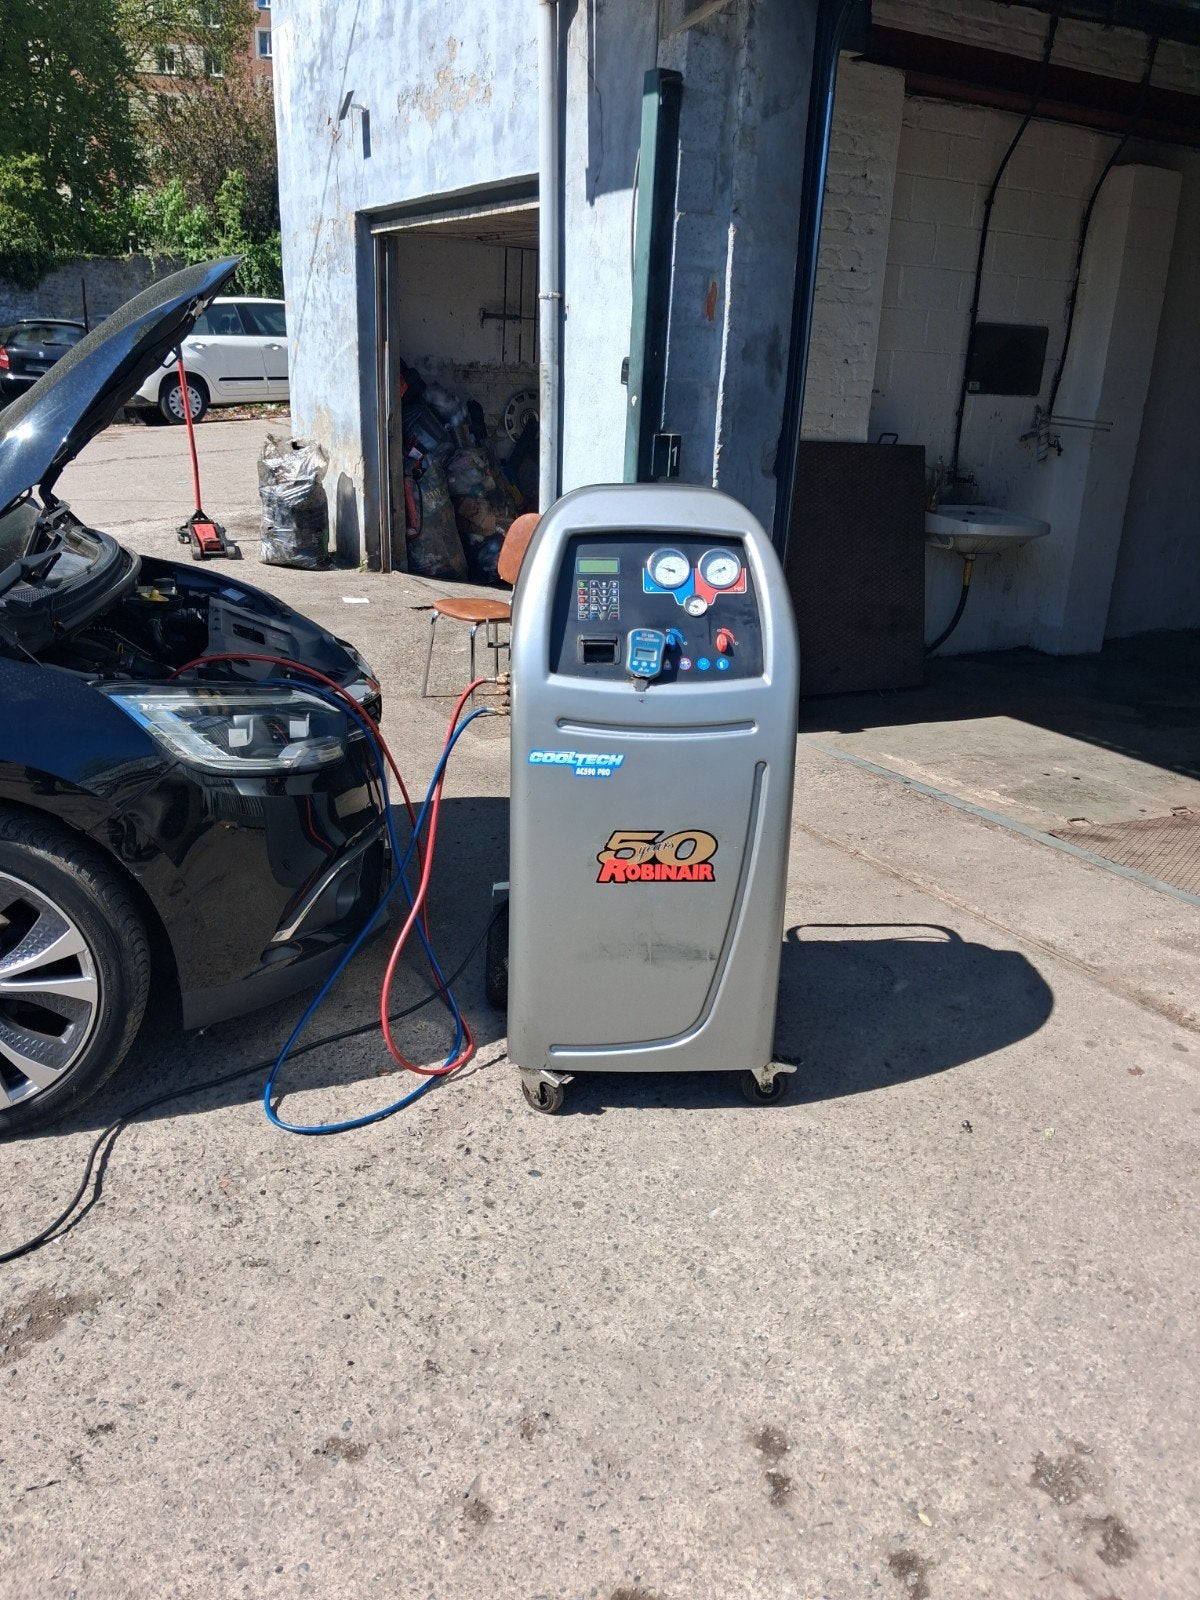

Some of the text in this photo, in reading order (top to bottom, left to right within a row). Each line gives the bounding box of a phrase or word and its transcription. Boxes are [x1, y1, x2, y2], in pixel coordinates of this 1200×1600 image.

[671, 446, 678, 467] 1
[529, 751, 624, 767] COOLTECH
[597, 768, 611, 777] PRO
[597, 829, 719, 866] 50
[597, 858, 716, 883] ROBINAIR
